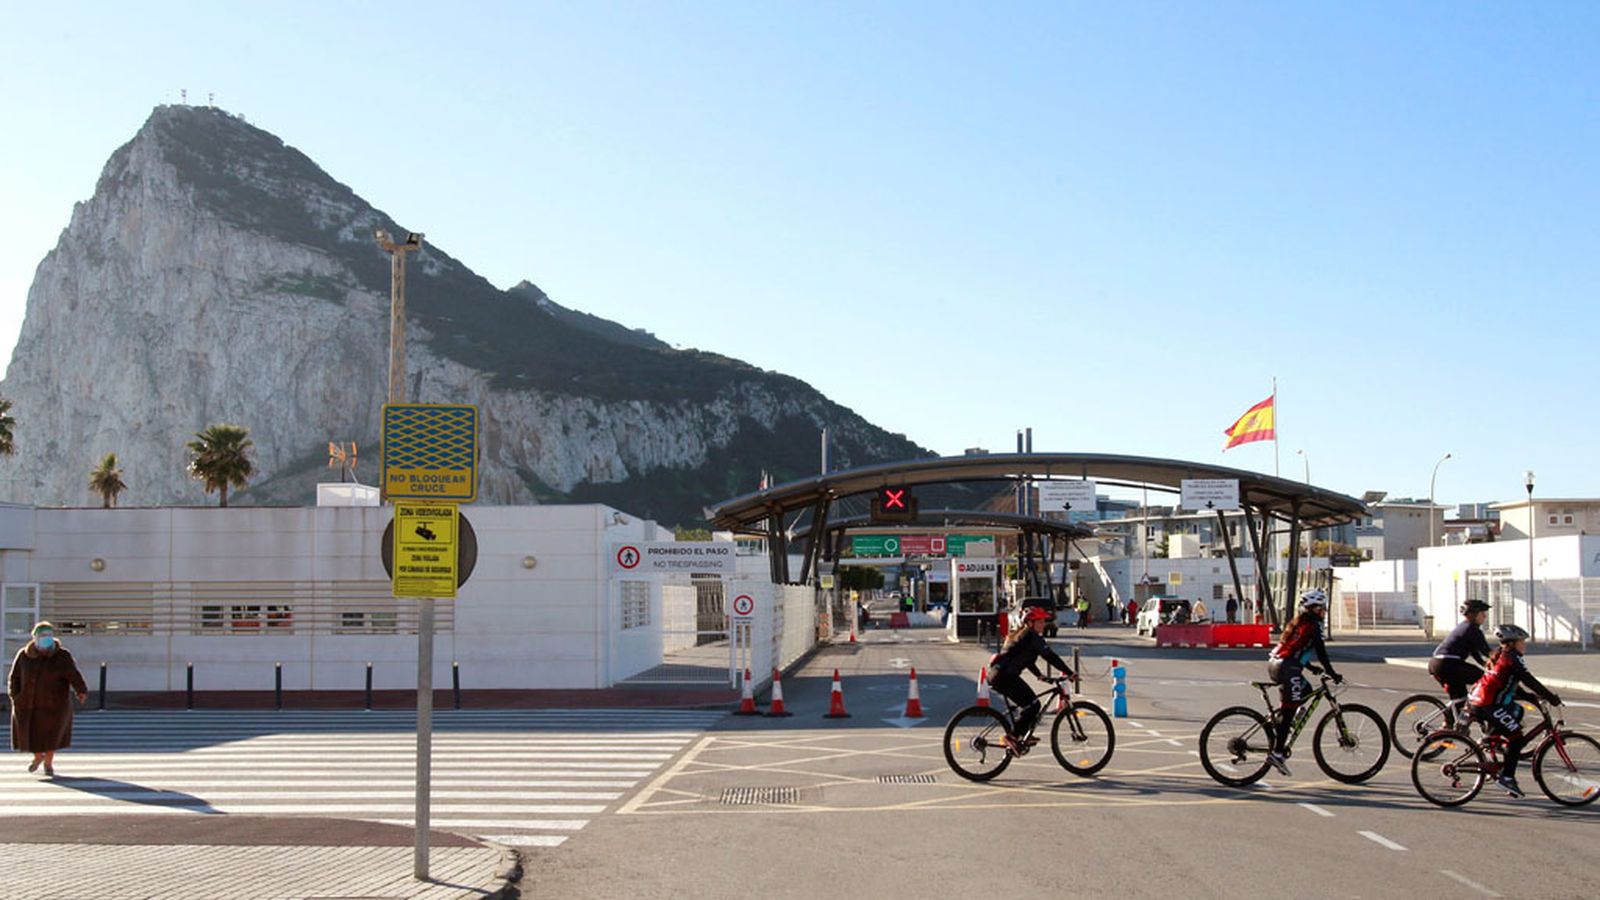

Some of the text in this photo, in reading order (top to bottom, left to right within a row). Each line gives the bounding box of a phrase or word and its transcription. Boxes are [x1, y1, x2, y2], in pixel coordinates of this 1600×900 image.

[390, 474, 466, 483] NO BLOQUEAR
[411, 484, 446, 492] CRUCE
[648, 547, 728, 556] PROHIBIDO EL PASO
[654, 560, 723, 568] NO TRESPASSING
[1493, 708, 1520, 732] UCM
